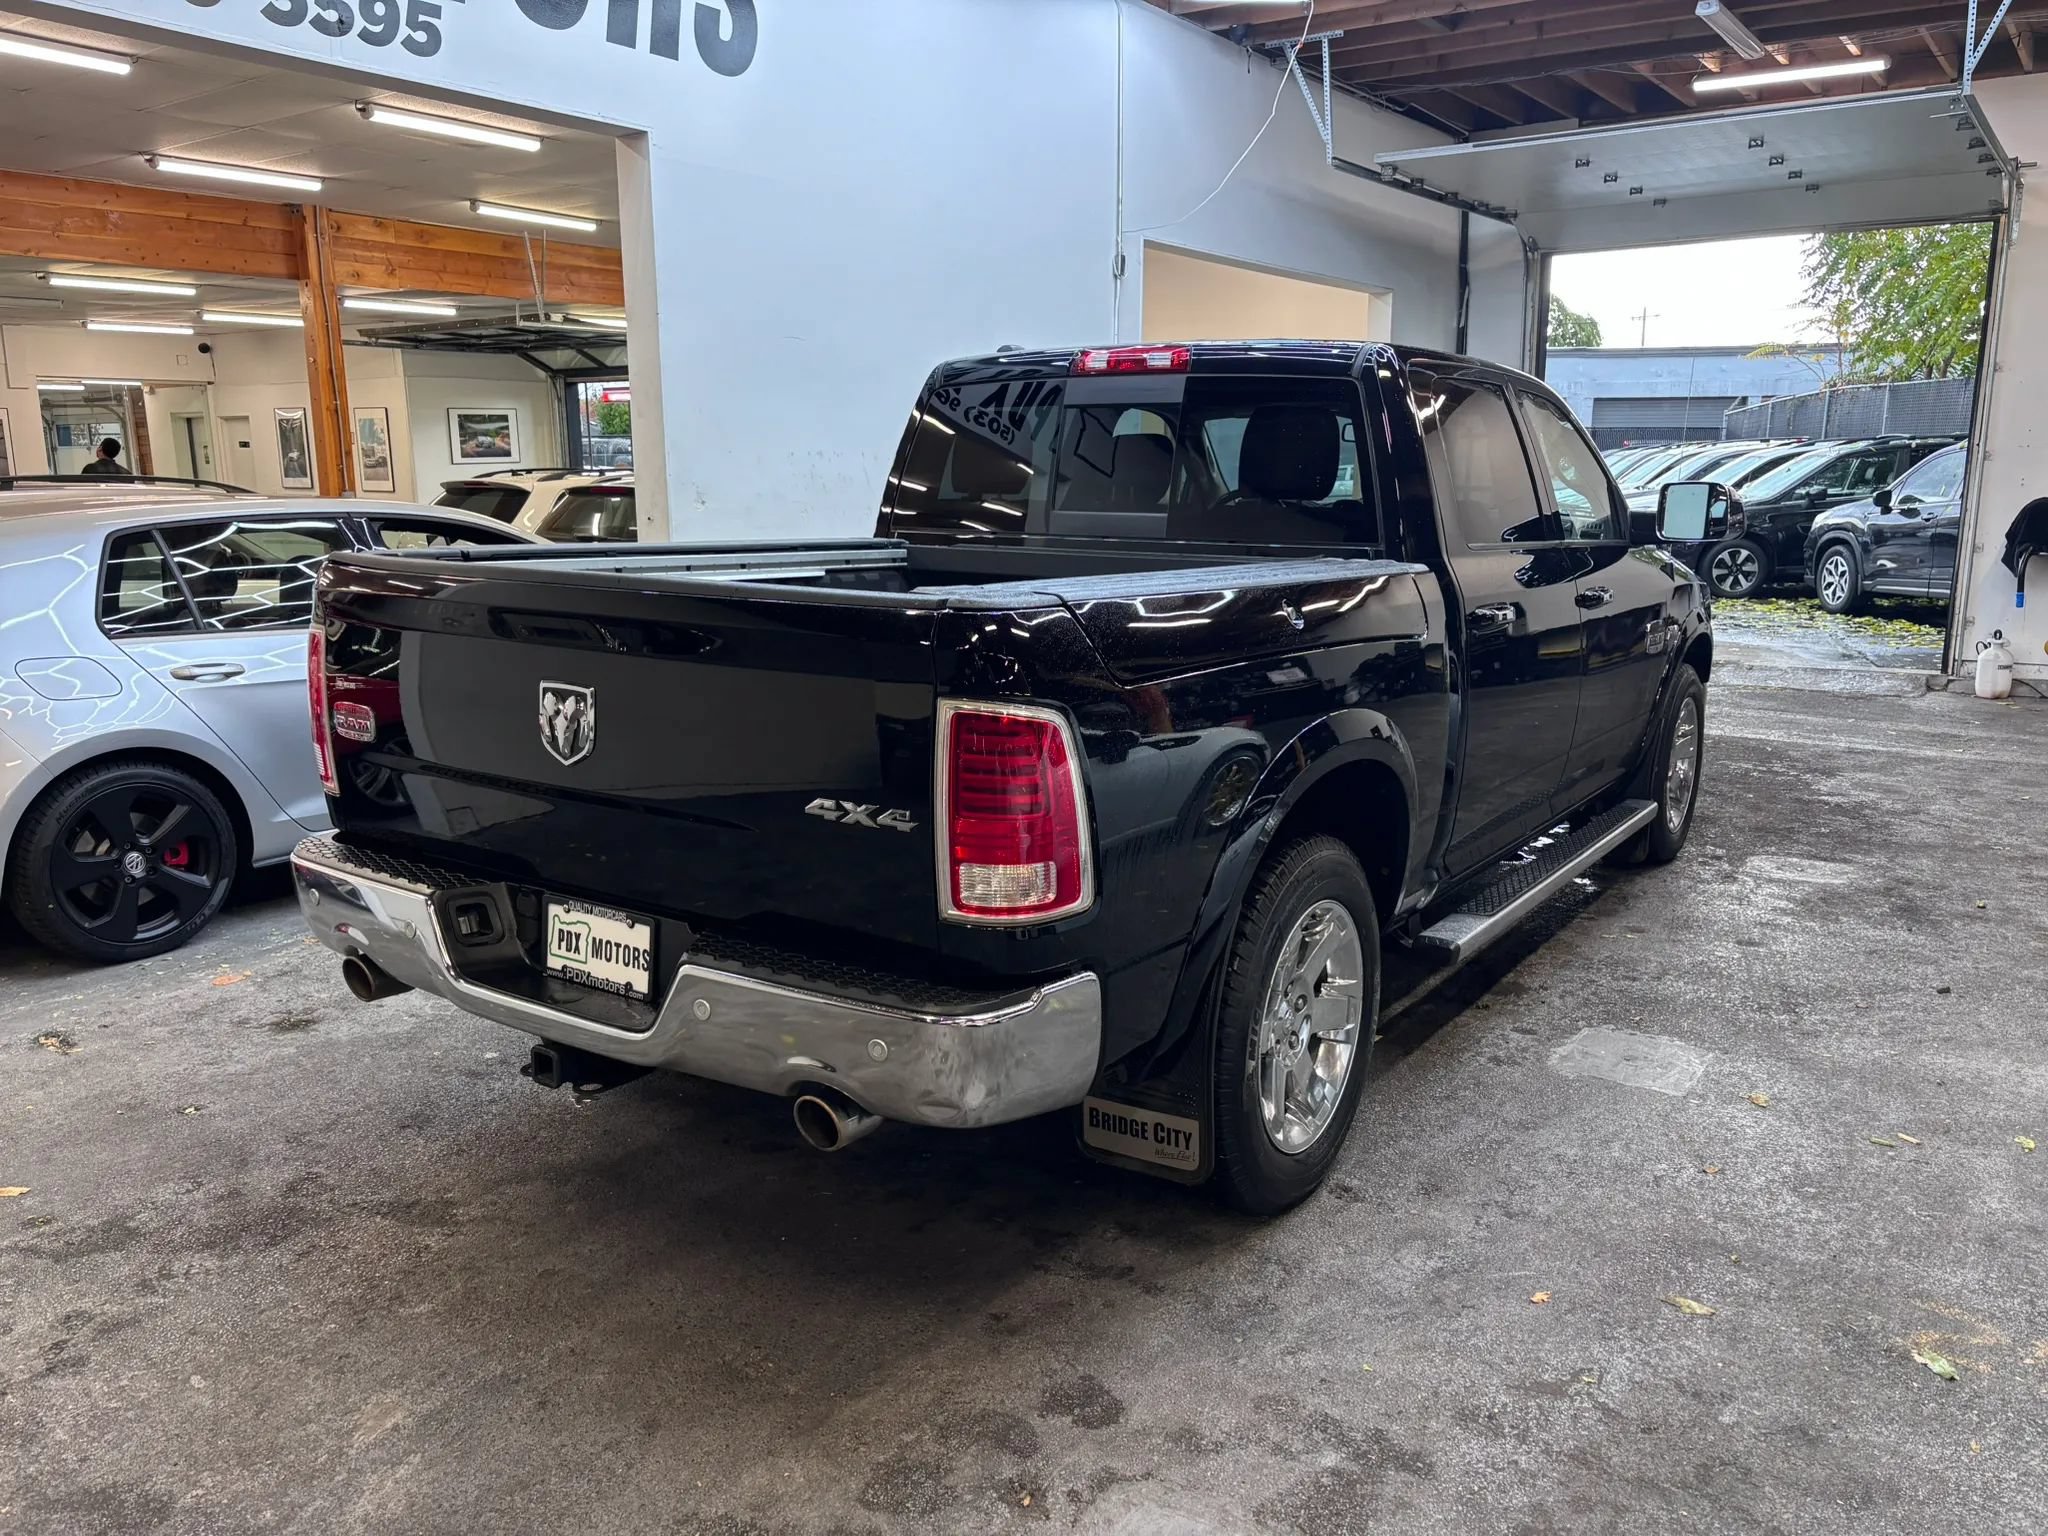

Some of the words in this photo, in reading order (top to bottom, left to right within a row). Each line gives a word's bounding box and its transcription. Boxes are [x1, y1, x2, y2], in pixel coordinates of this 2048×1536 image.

[568, 900, 592, 914] QUALITY
[593, 905, 627, 923] MOTORCARS
[557, 928, 582, 955] PDX
[591, 937, 650, 972] MOTORS
[1088, 1106, 1149, 1141] BRIDGE
[1153, 1122, 1193, 1151] CITY
